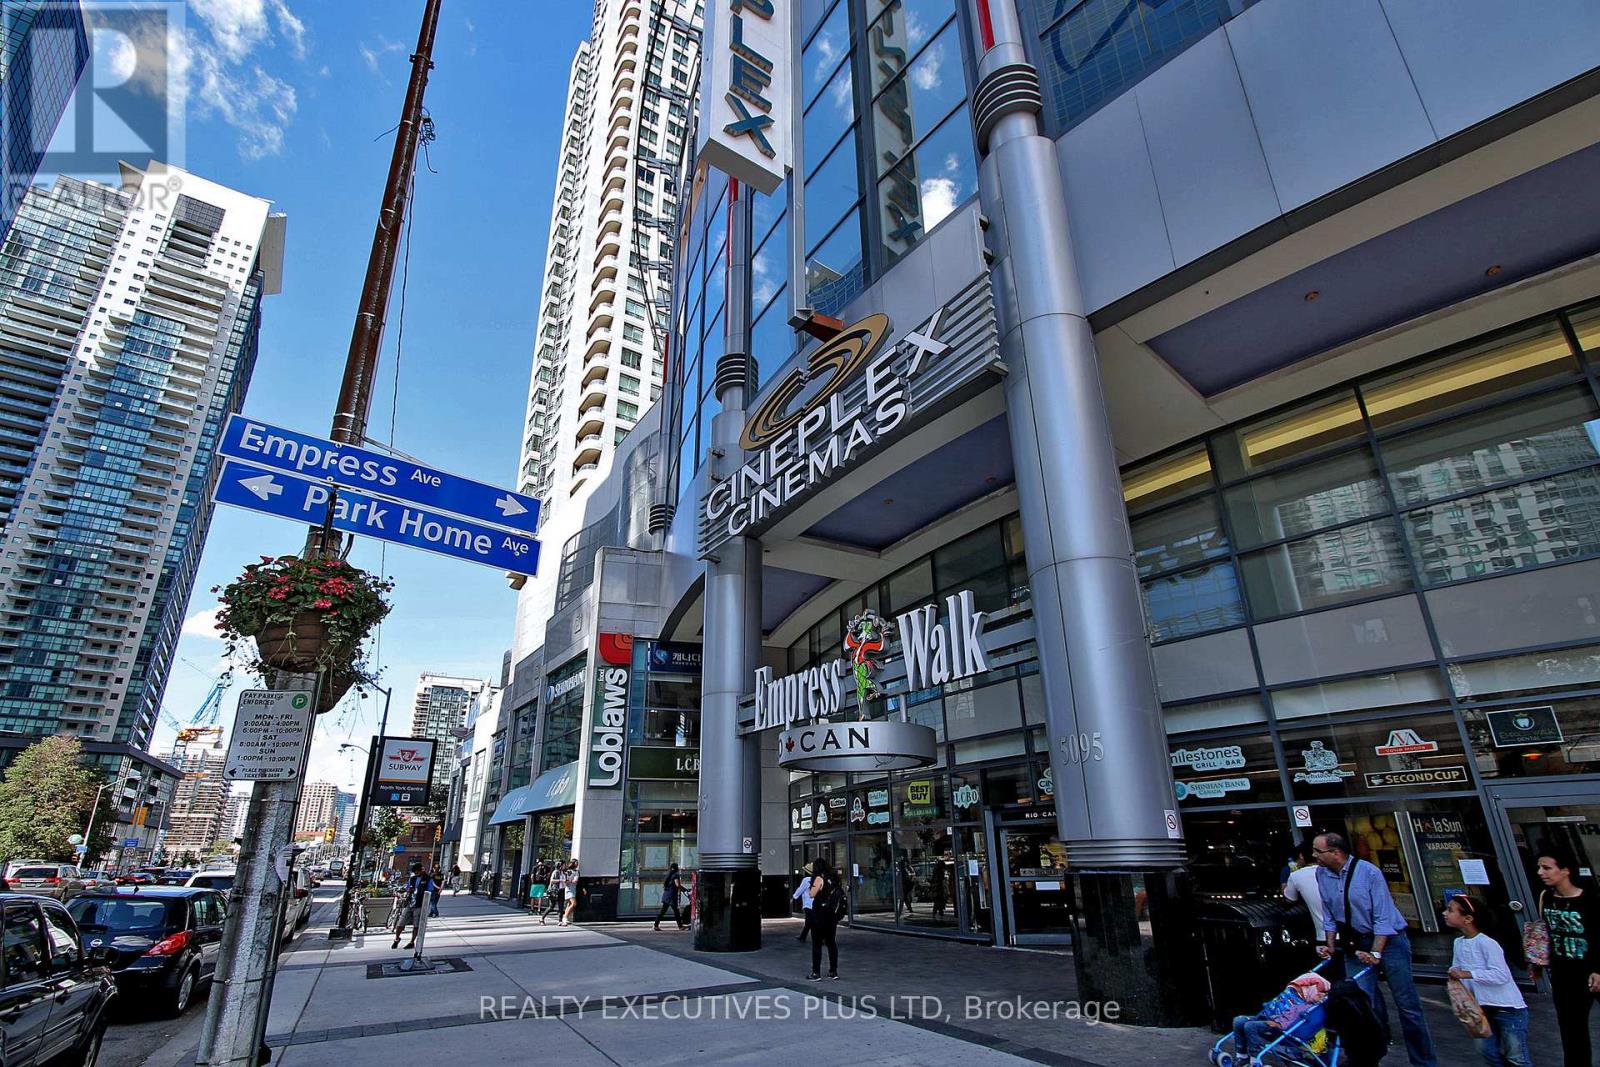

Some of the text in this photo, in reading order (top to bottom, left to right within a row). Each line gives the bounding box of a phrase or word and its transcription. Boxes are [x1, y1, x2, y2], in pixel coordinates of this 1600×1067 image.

[706, 305, 951, 521] CINEPLEX
[239, 422, 442, 488] Empress Ave
[728, 390, 911, 536] CINEMAS
[303, 485, 530, 556] Park Home Ave
[754, 589, 992, 730] Empress Walk
[589, 667, 628, 788] Loblaws
[800, 727, 870, 753] CAN
[1059, 732, 1104, 766] 5095
[388, 763, 422, 771] SUBWAY
[1385, 770, 1460, 784] SECOND CUP
[955, 789, 978, 804] LCBO
[1191, 783, 1223, 791] SHINHAN
[1426, 842, 1462, 850] VARADERO
